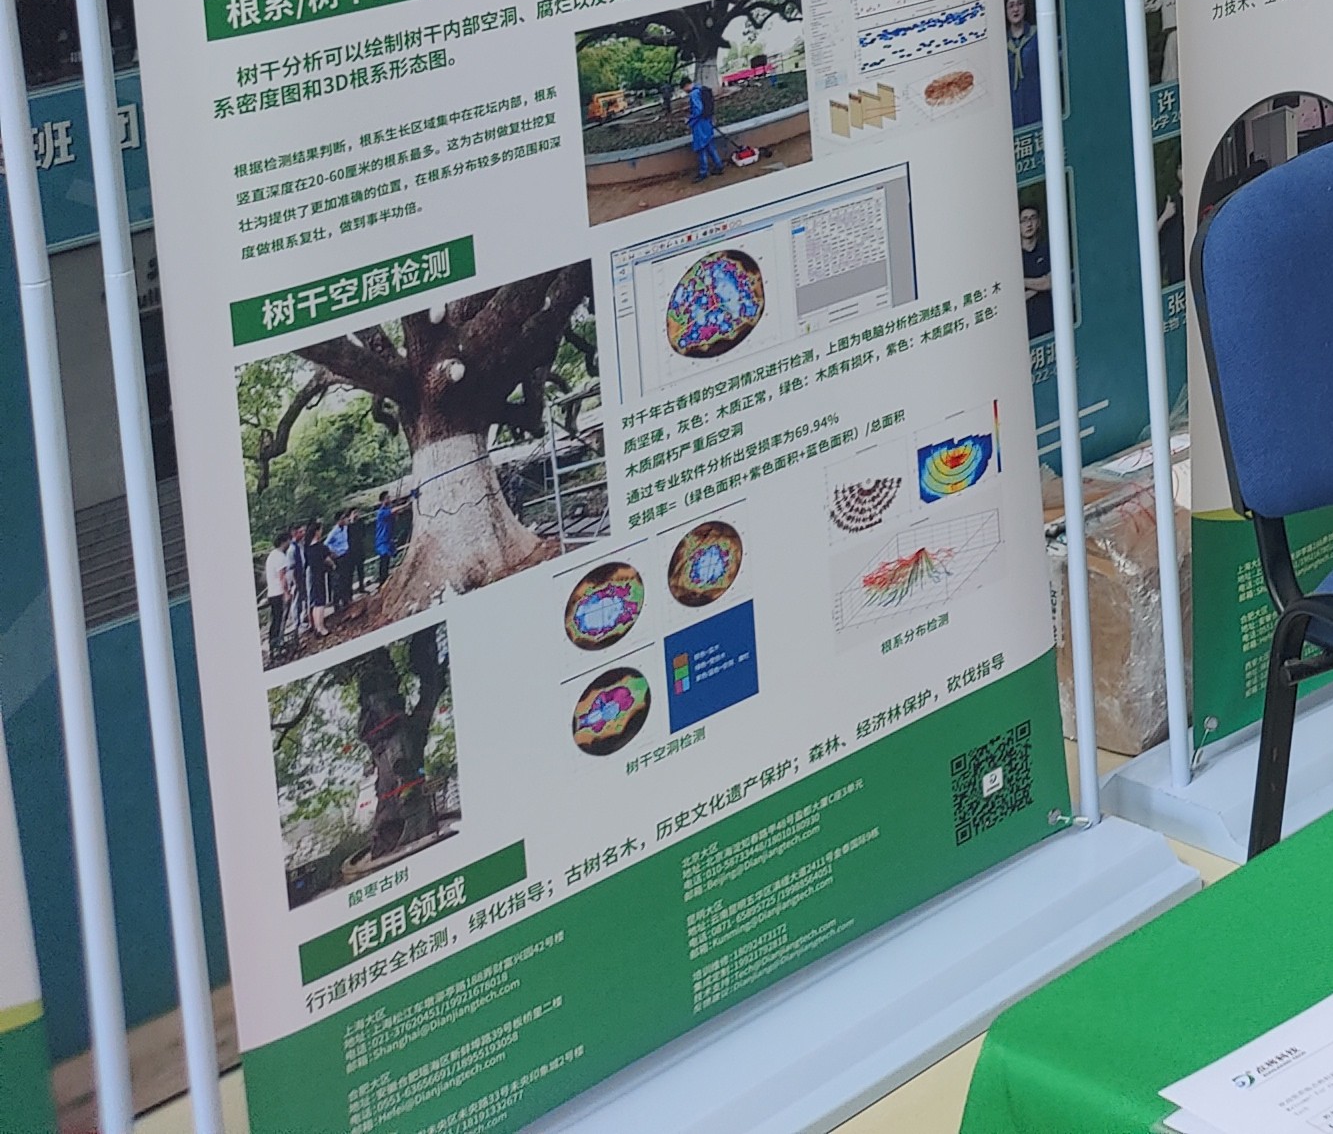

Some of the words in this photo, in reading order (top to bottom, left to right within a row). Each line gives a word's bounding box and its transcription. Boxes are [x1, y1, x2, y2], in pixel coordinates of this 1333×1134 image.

[213, 48, 456, 120] 系密度图和3D根系形态图。
[261, 247, 451, 331] 树干空腐检测
[347, 875, 469, 958] 使用领域
